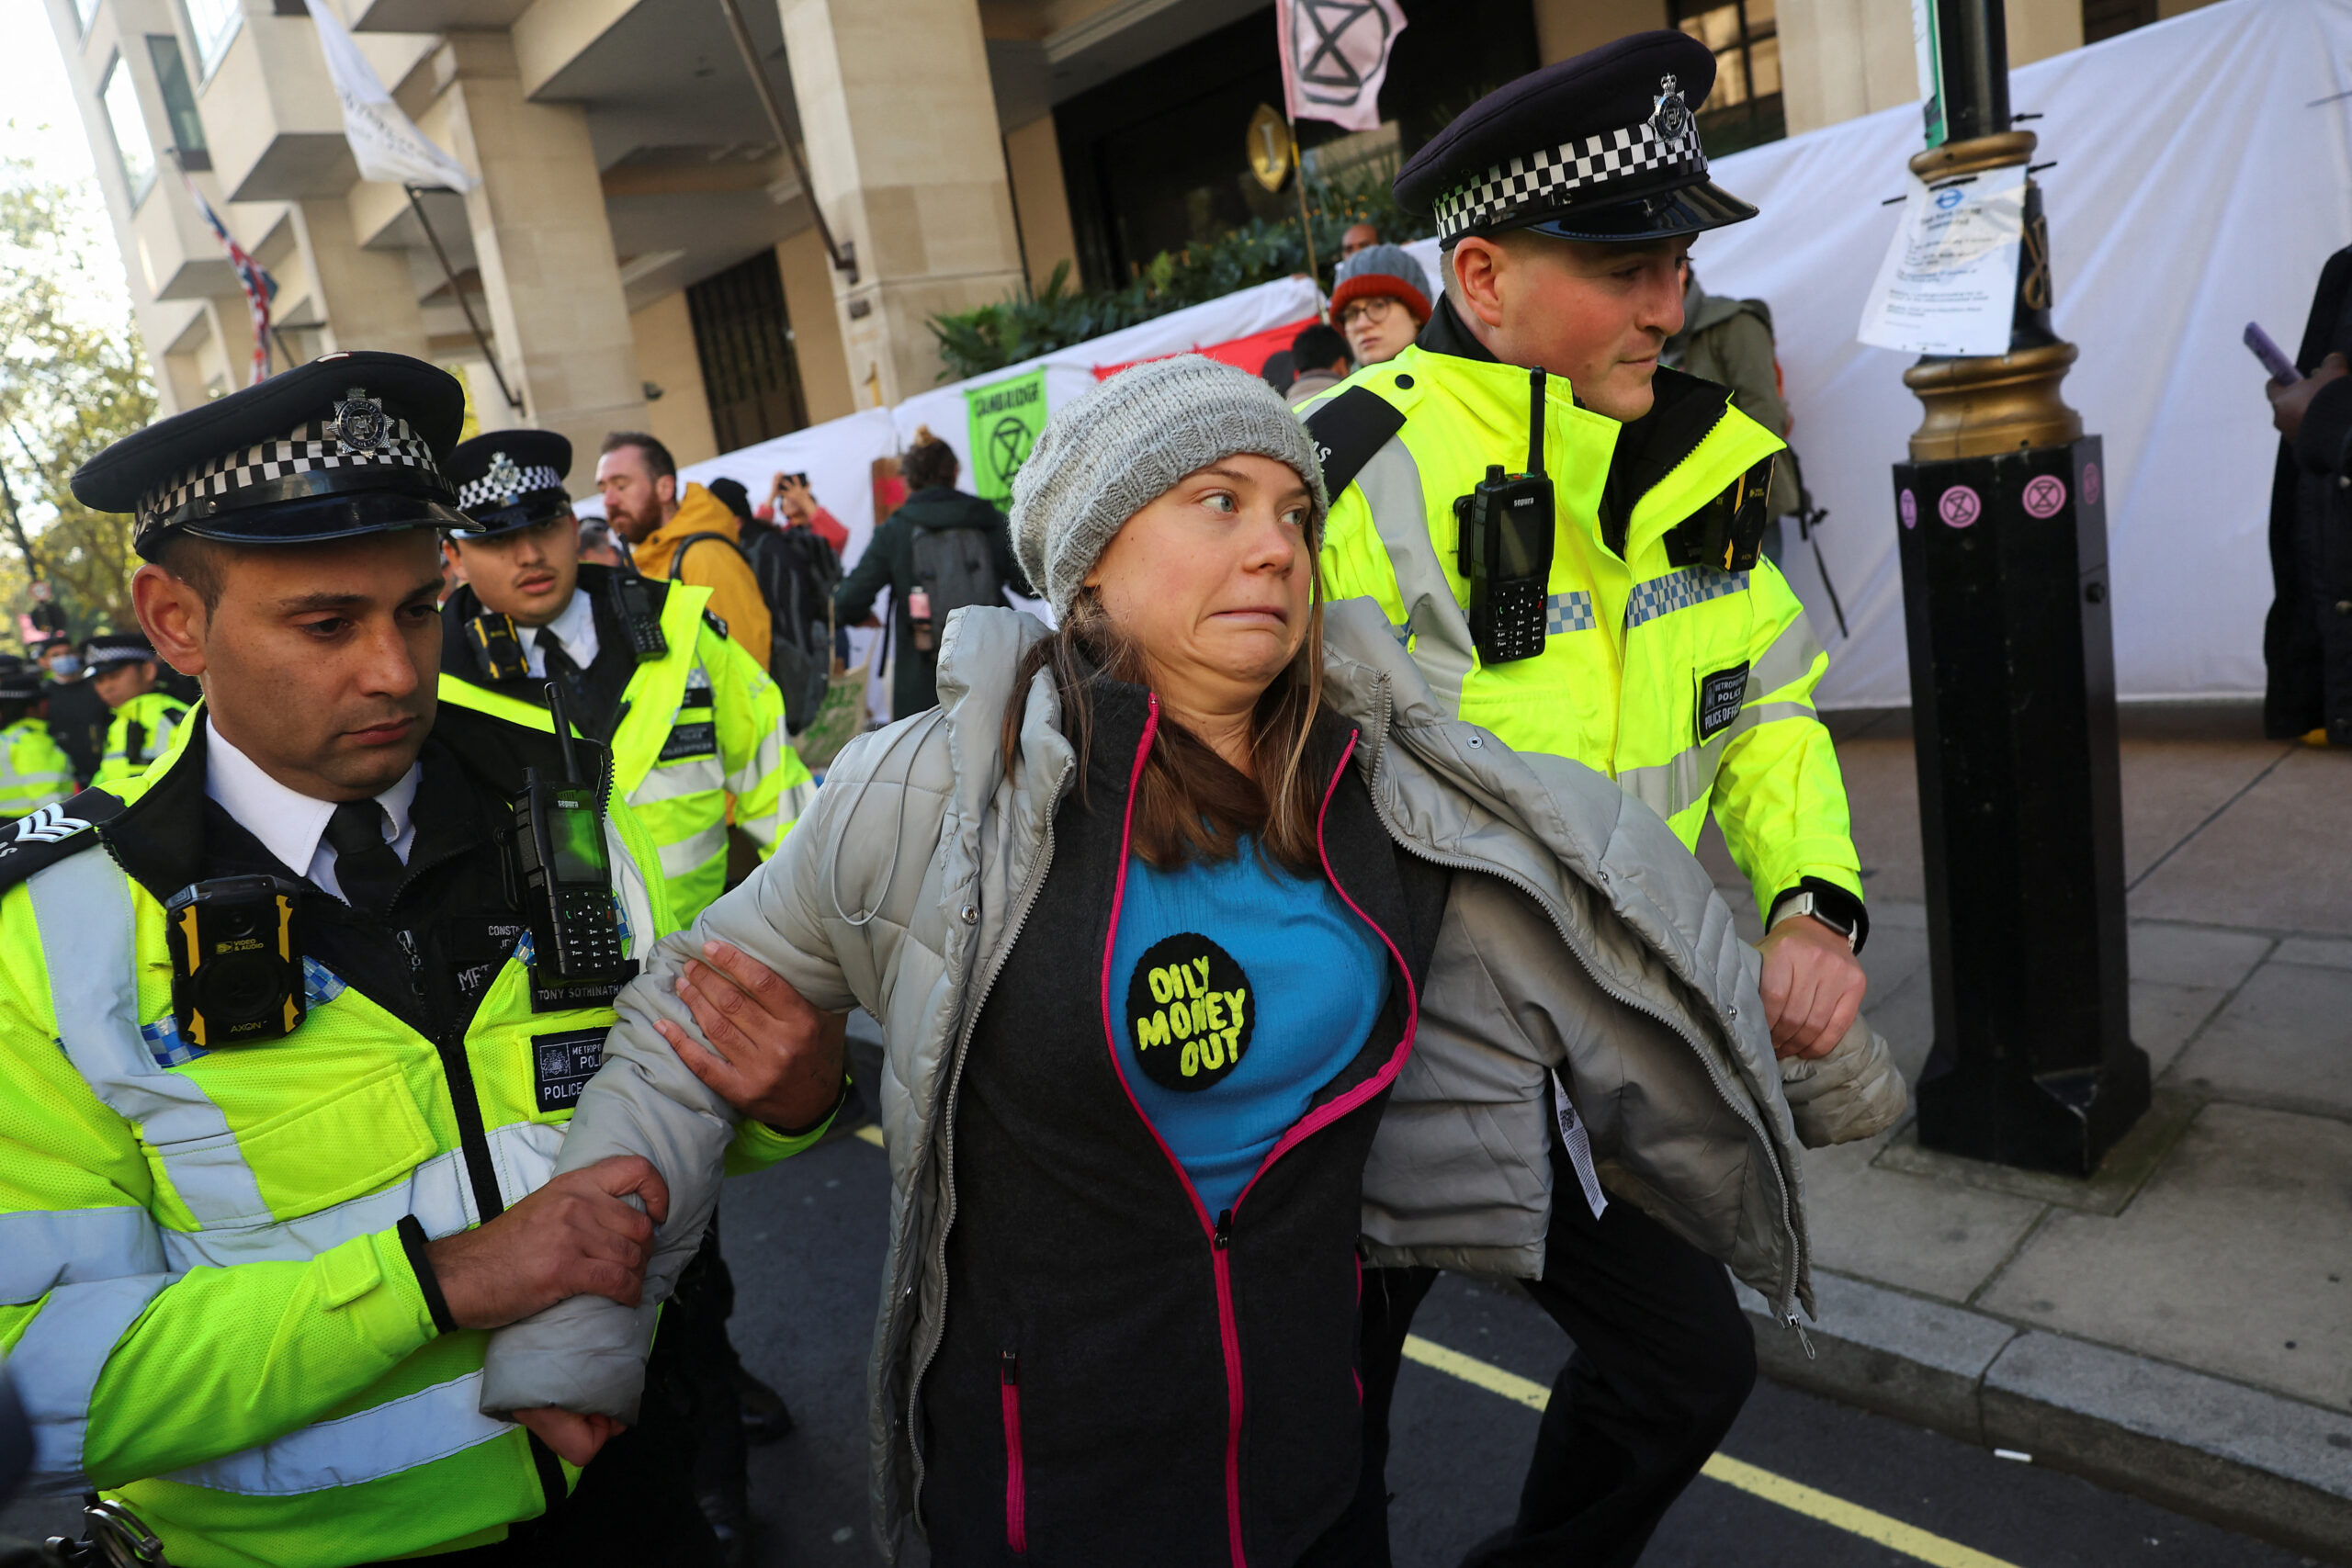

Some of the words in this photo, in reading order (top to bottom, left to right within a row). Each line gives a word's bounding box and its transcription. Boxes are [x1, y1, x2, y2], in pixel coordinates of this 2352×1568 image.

[241, 942, 265, 951] AUDIO
[1148, 955, 1209, 1004] OILY
[537, 988, 565, 1000] TONY
[231, 1022, 262, 1033] AXON
[1136, 987, 1246, 1051] MONEY
[1180, 1026, 1241, 1077] OUT
[544, 1082, 583, 1101] POLICE
